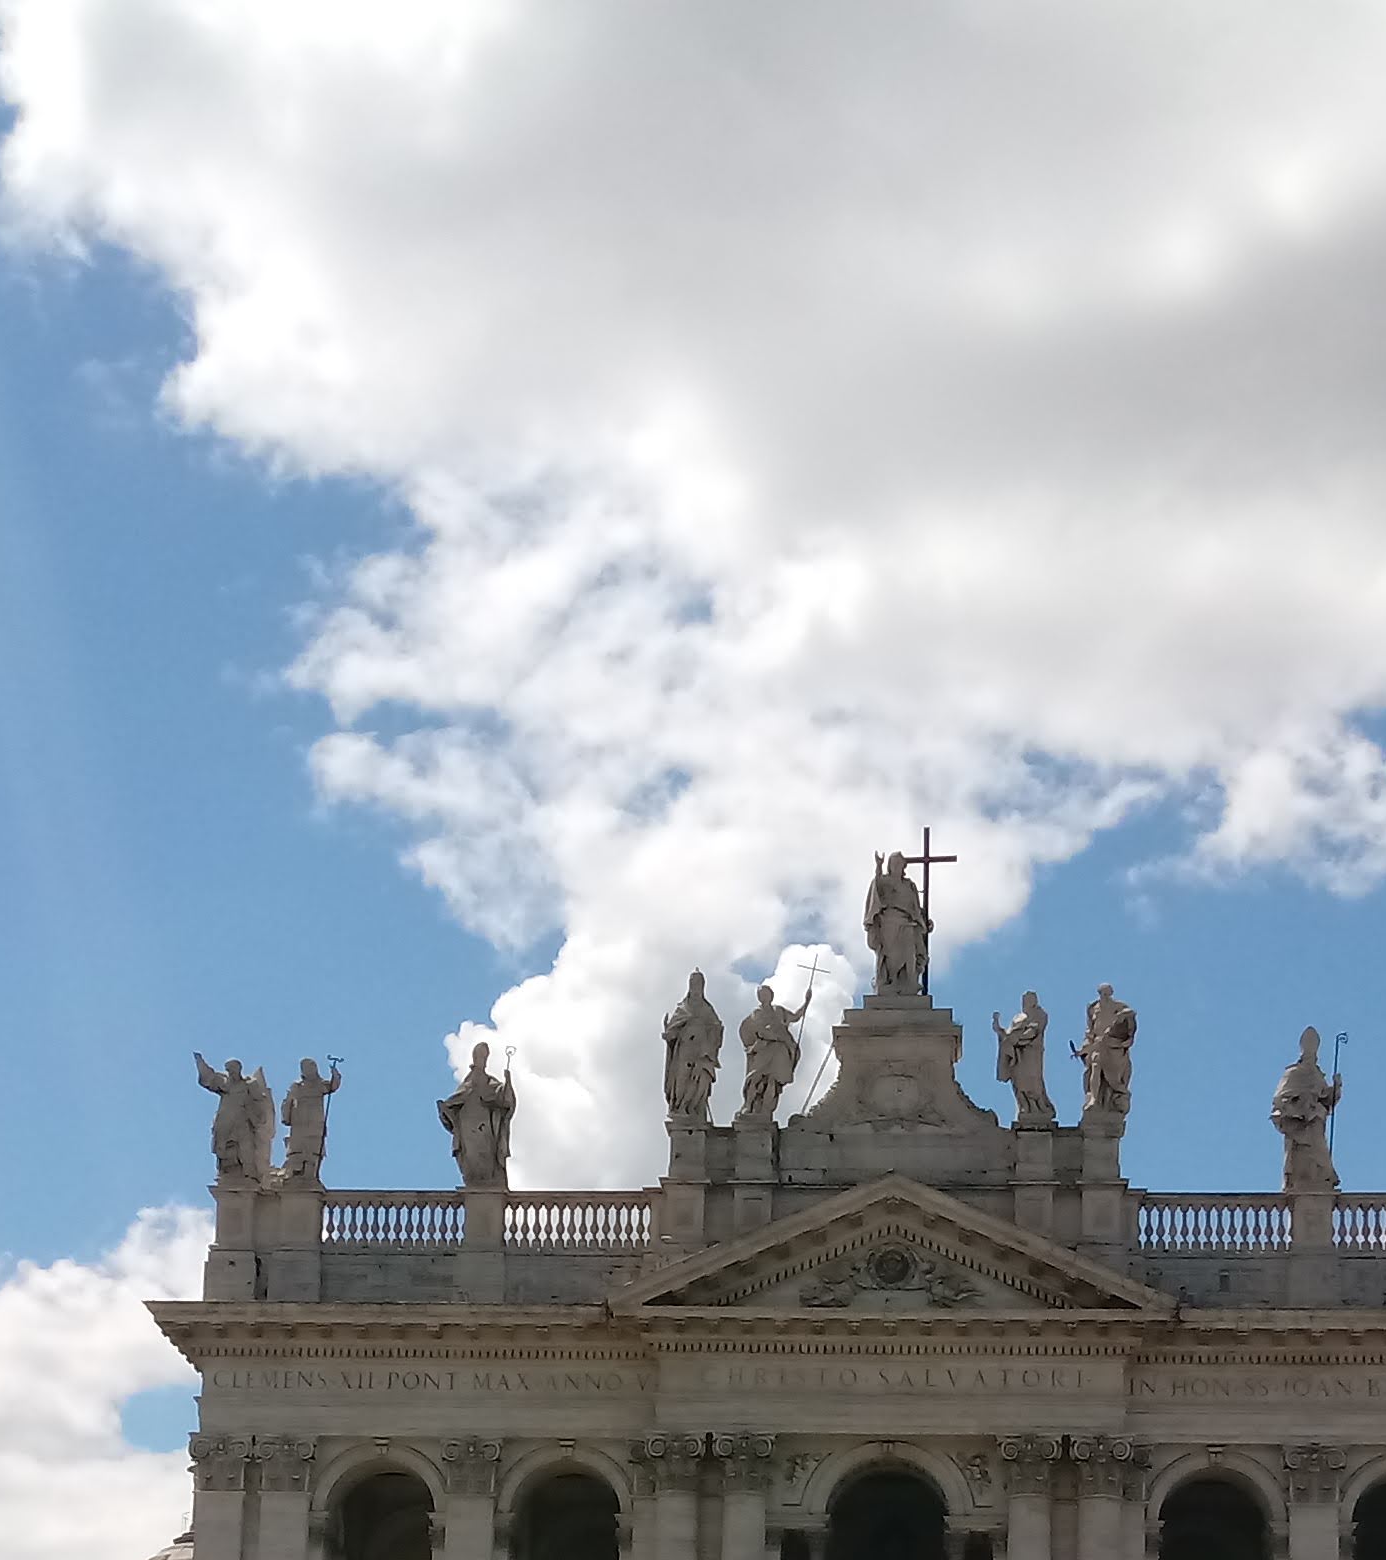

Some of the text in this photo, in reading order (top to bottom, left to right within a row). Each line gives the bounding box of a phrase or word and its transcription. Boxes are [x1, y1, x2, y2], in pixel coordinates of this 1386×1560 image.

[213, 1370, 328, 1390] CLEMENS
[340, 1371, 375, 1390] XII
[386, 1372, 456, 1391] PONT
[472, 1373, 531, 1392] MAX
[544, 1373, 623, 1392] ANNO
[700, 1367, 1084, 1388] CHRISTO SALVATORI
[1127, 1377, 1157, 1397] IN
[1169, 1377, 1231, 1397] HON
[1243, 1378, 1270, 1397] SS
[1282, 1378, 1355, 1398] IOAN
